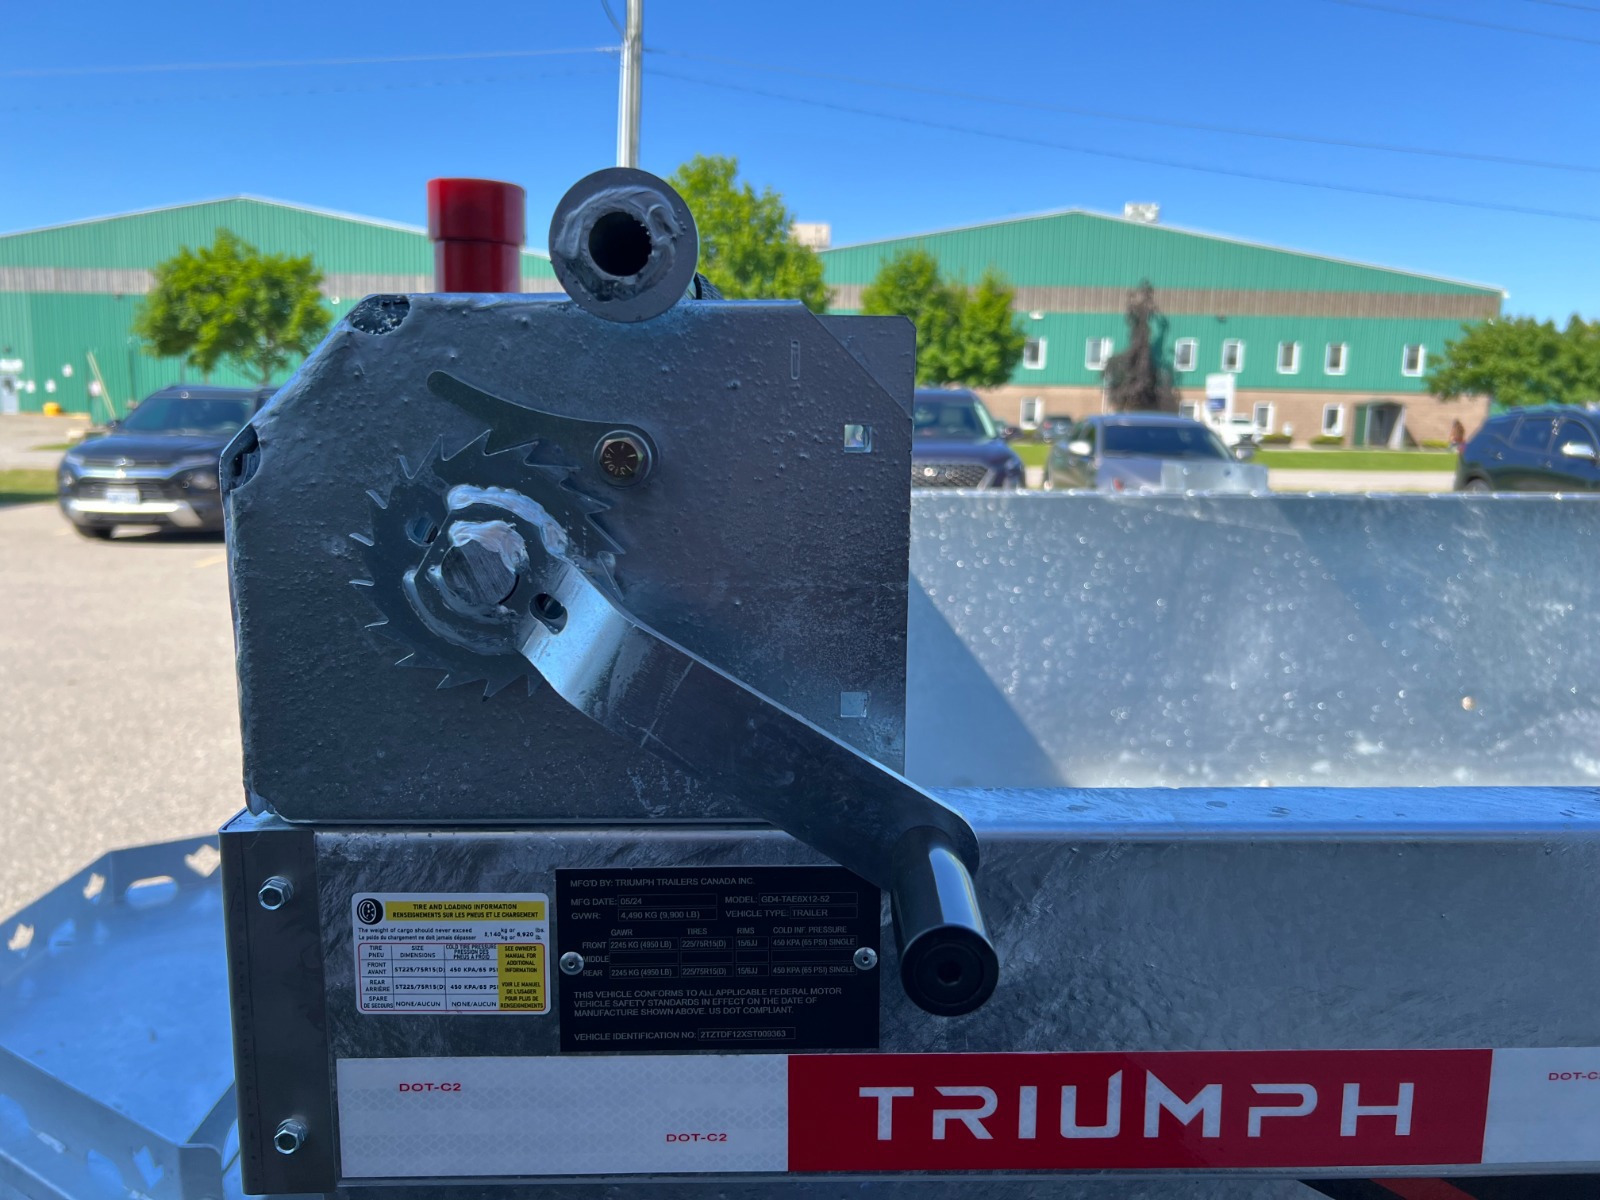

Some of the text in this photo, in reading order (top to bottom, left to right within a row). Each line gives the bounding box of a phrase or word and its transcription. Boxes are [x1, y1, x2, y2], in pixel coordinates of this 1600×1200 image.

[615, 878, 654, 887] TRIUMPH
[656, 878, 698, 886] TRAILERS
[701, 878, 736, 886] CANADA
[570, 897, 642, 906] MFG DATE: 05/24
[724, 896, 758, 904] MODEL:
[571, 912, 601, 920] GVWR:
[620, 911, 642, 920] 4,490
[660, 911, 684, 920] (9,900
[686, 910, 700, 920] LB)
[726, 910, 762, 918] VEHICLE
[765, 909, 789, 917] TYPE:
[772, 926, 848, 934] COLD INF. PRESSURE
[610, 941, 626, 949] 2245
[628, 941, 638, 949] KG
[640, 940, 658, 950] (4950
[660, 940, 672, 950] LB)
[802, 938, 812, 948] (65
[814, 938, 828, 948] PSI)
[829, 938, 855, 946] SINGLE
[640, 968, 659, 978] (4950
[660, 968, 672, 977] LB)
[772, 966, 855, 975] 450 KPA (65 PSI) SINGLE
[595, 990, 632, 998] VEHICLE
[634, 990, 684, 998] CONFORMS
[716, 988, 768, 996] APPLICABLE
[770, 988, 808, 996] FEDERAL
[810, 987, 842, 995] MOTOR
[574, 1000, 610, 1008] VEHICLE
[648, 998, 700, 1007] STANDARDS
[702, 998, 710, 1006] IN
[712, 998, 745, 1006] EFFECT
[762, 997, 780, 1005] THE
[782, 996, 804, 1004] DATE
[806, 996, 818, 1004] OF
[574, 1009, 639, 1017] MANUFACTURE
[640, 1008, 674, 1016] SHOWN
[675, 1008, 706, 1016] ABOVE.
[743, 1006, 794, 1014] COMPLIANT.
[574, 1033, 610, 1041] VEHICLE
[612, 1032, 680, 1040] IDENTIFICATION
[682, 1032, 697, 1040] NO:
[1548, 1072, 1600, 1080] DOT-C
[399, 1082, 462, 1092] DOT-C2
[859, 1069, 1415, 1140] TRIUMPH
[666, 1133, 728, 1142] DOT-C2
